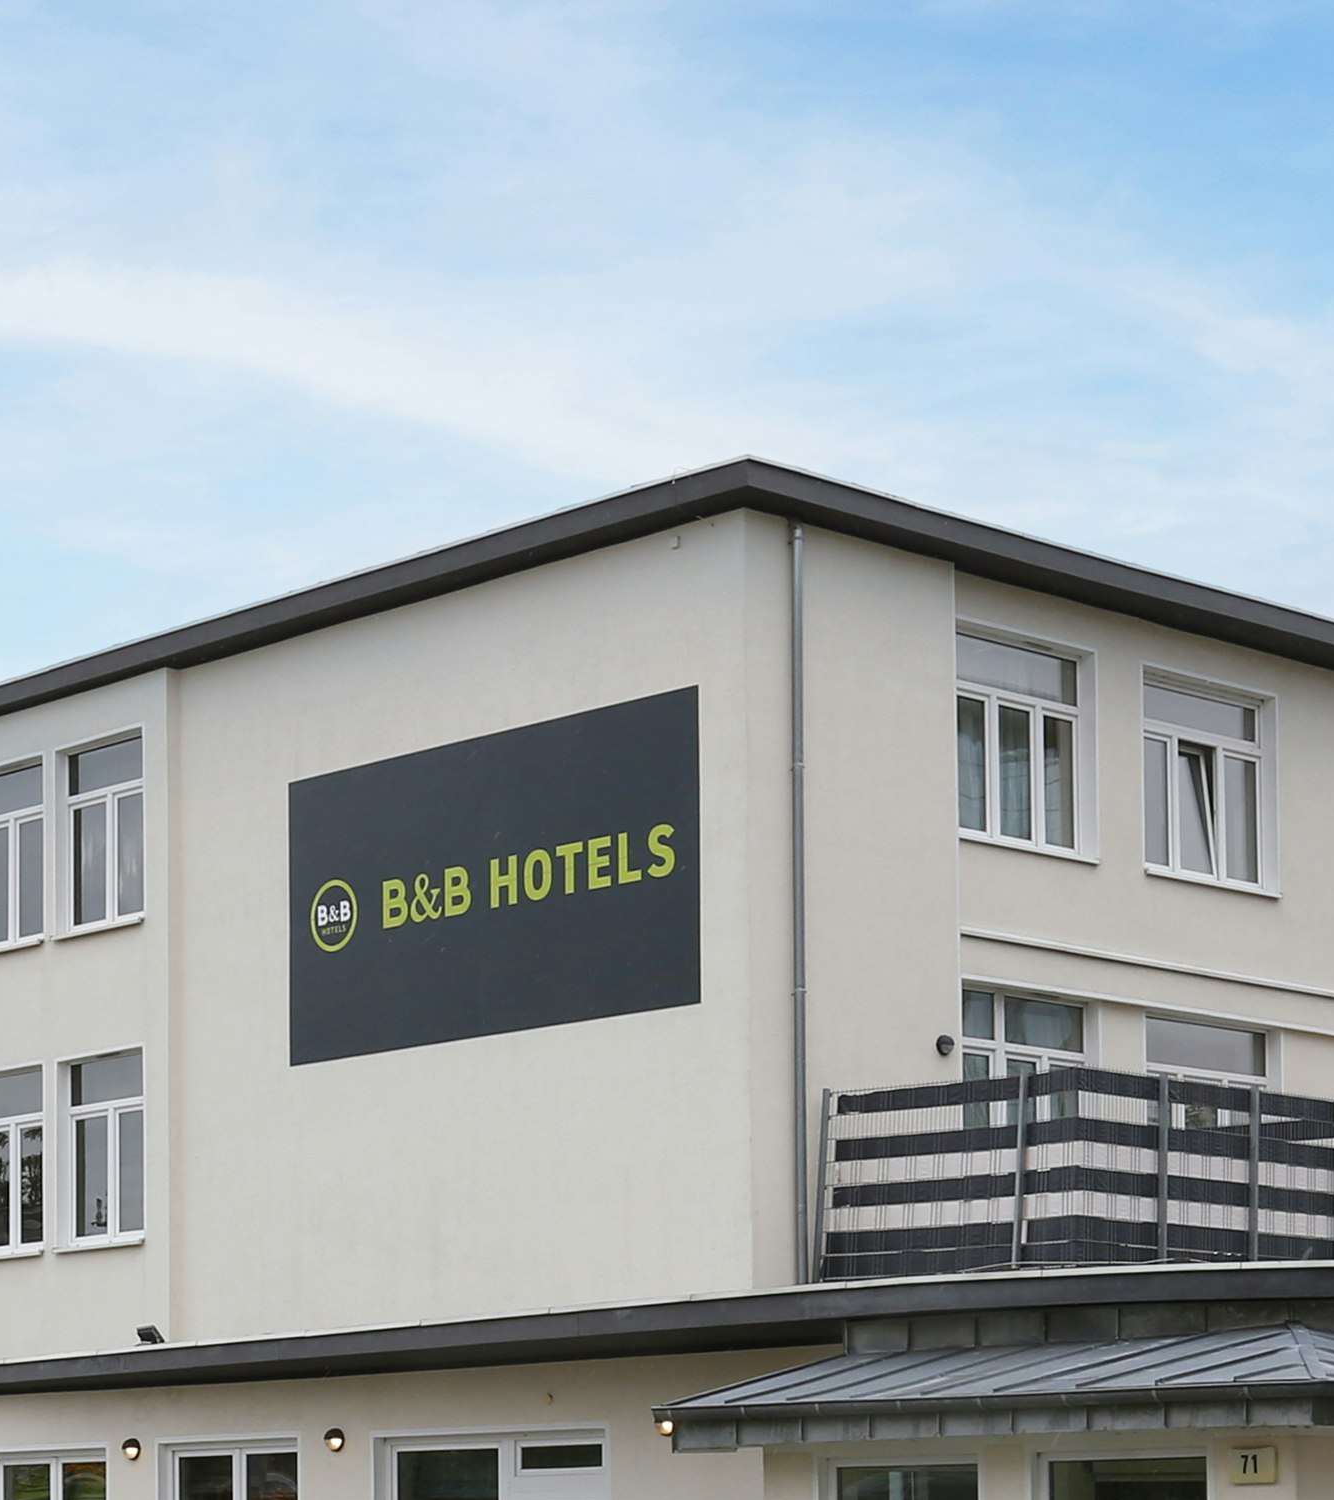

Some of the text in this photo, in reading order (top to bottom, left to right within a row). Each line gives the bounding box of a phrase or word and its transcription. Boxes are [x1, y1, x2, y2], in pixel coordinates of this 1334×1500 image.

[382, 823, 676, 929] B&B HOTELS
[317, 900, 351, 927] B&B
[321, 924, 347, 936] HOTELS
[1240, 1454, 1258, 1474] 71
